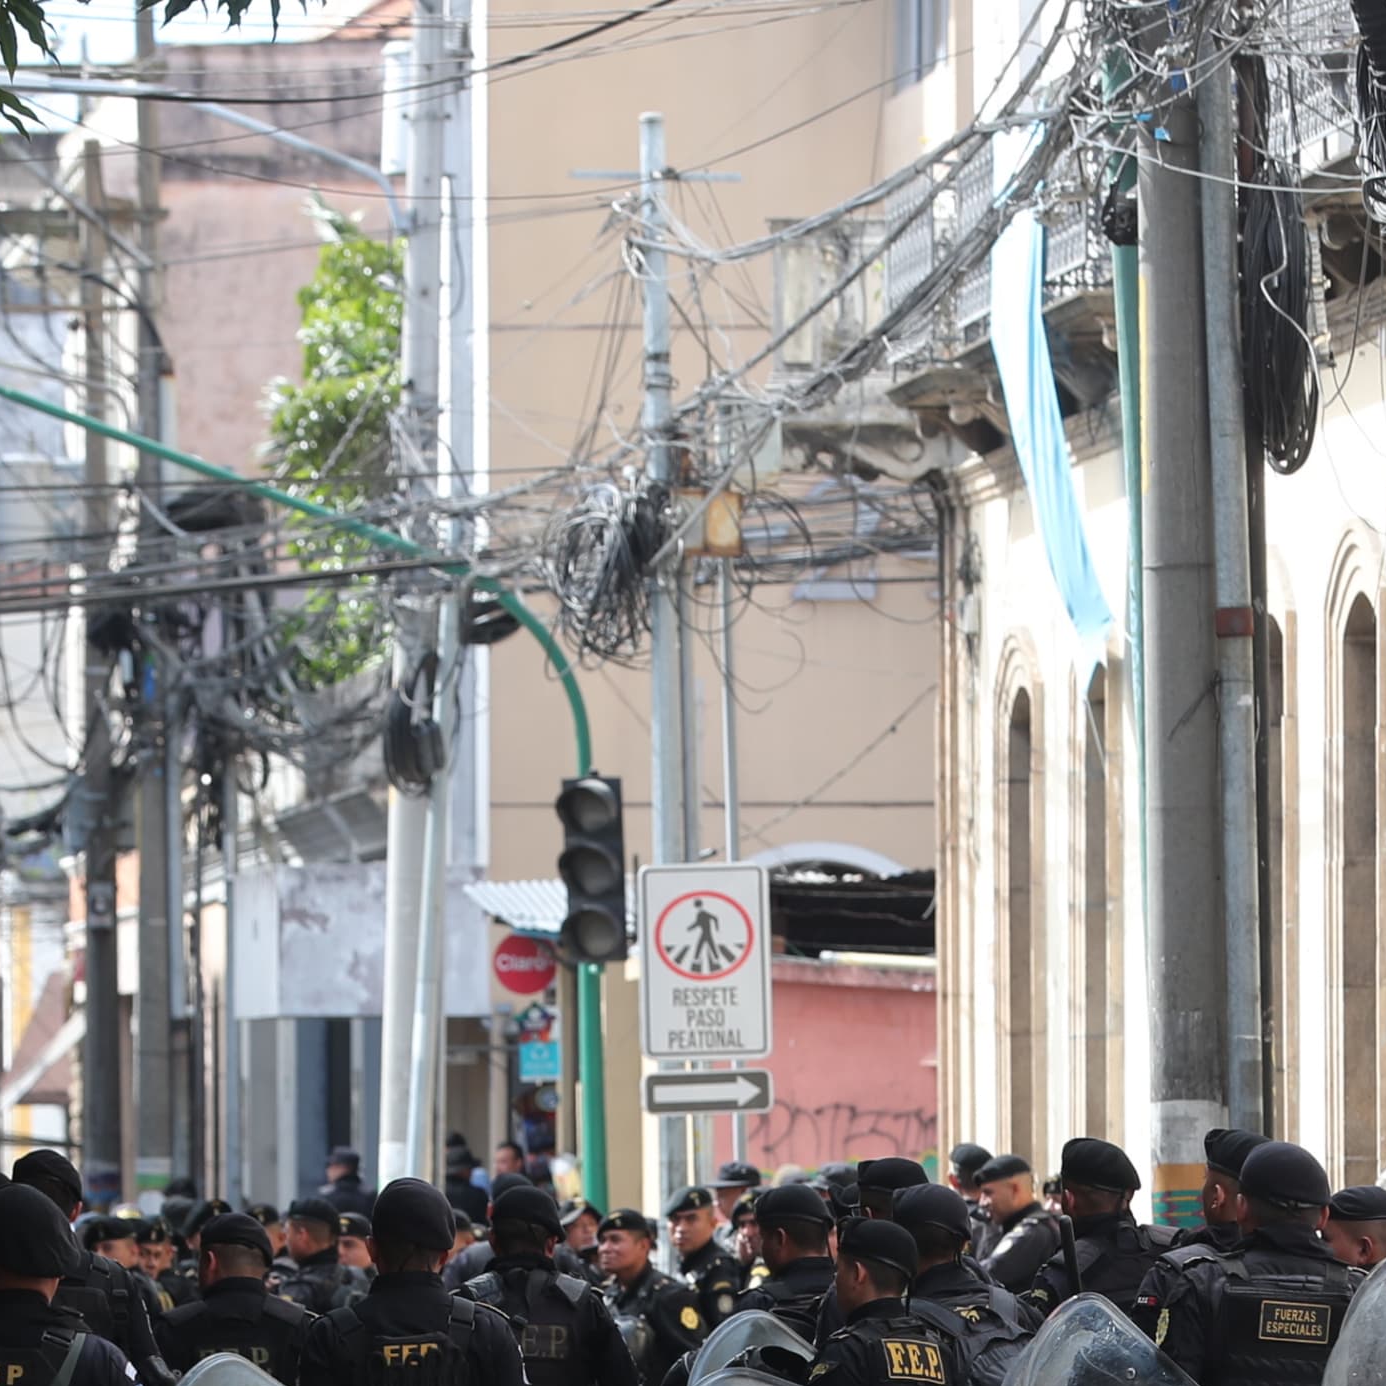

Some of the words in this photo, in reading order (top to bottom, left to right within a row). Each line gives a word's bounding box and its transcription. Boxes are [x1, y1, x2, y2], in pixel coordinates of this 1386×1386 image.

[672, 987, 738, 1006] RESPETE
[686, 1008, 725, 1027] PASO
[668, 1029, 744, 1048] PEATONAL
[1274, 1308, 1316, 1322] FUERZAS
[1266, 1320, 1323, 1336] ESPECIALES
[885, 1341, 942, 1380] F.E.P.
